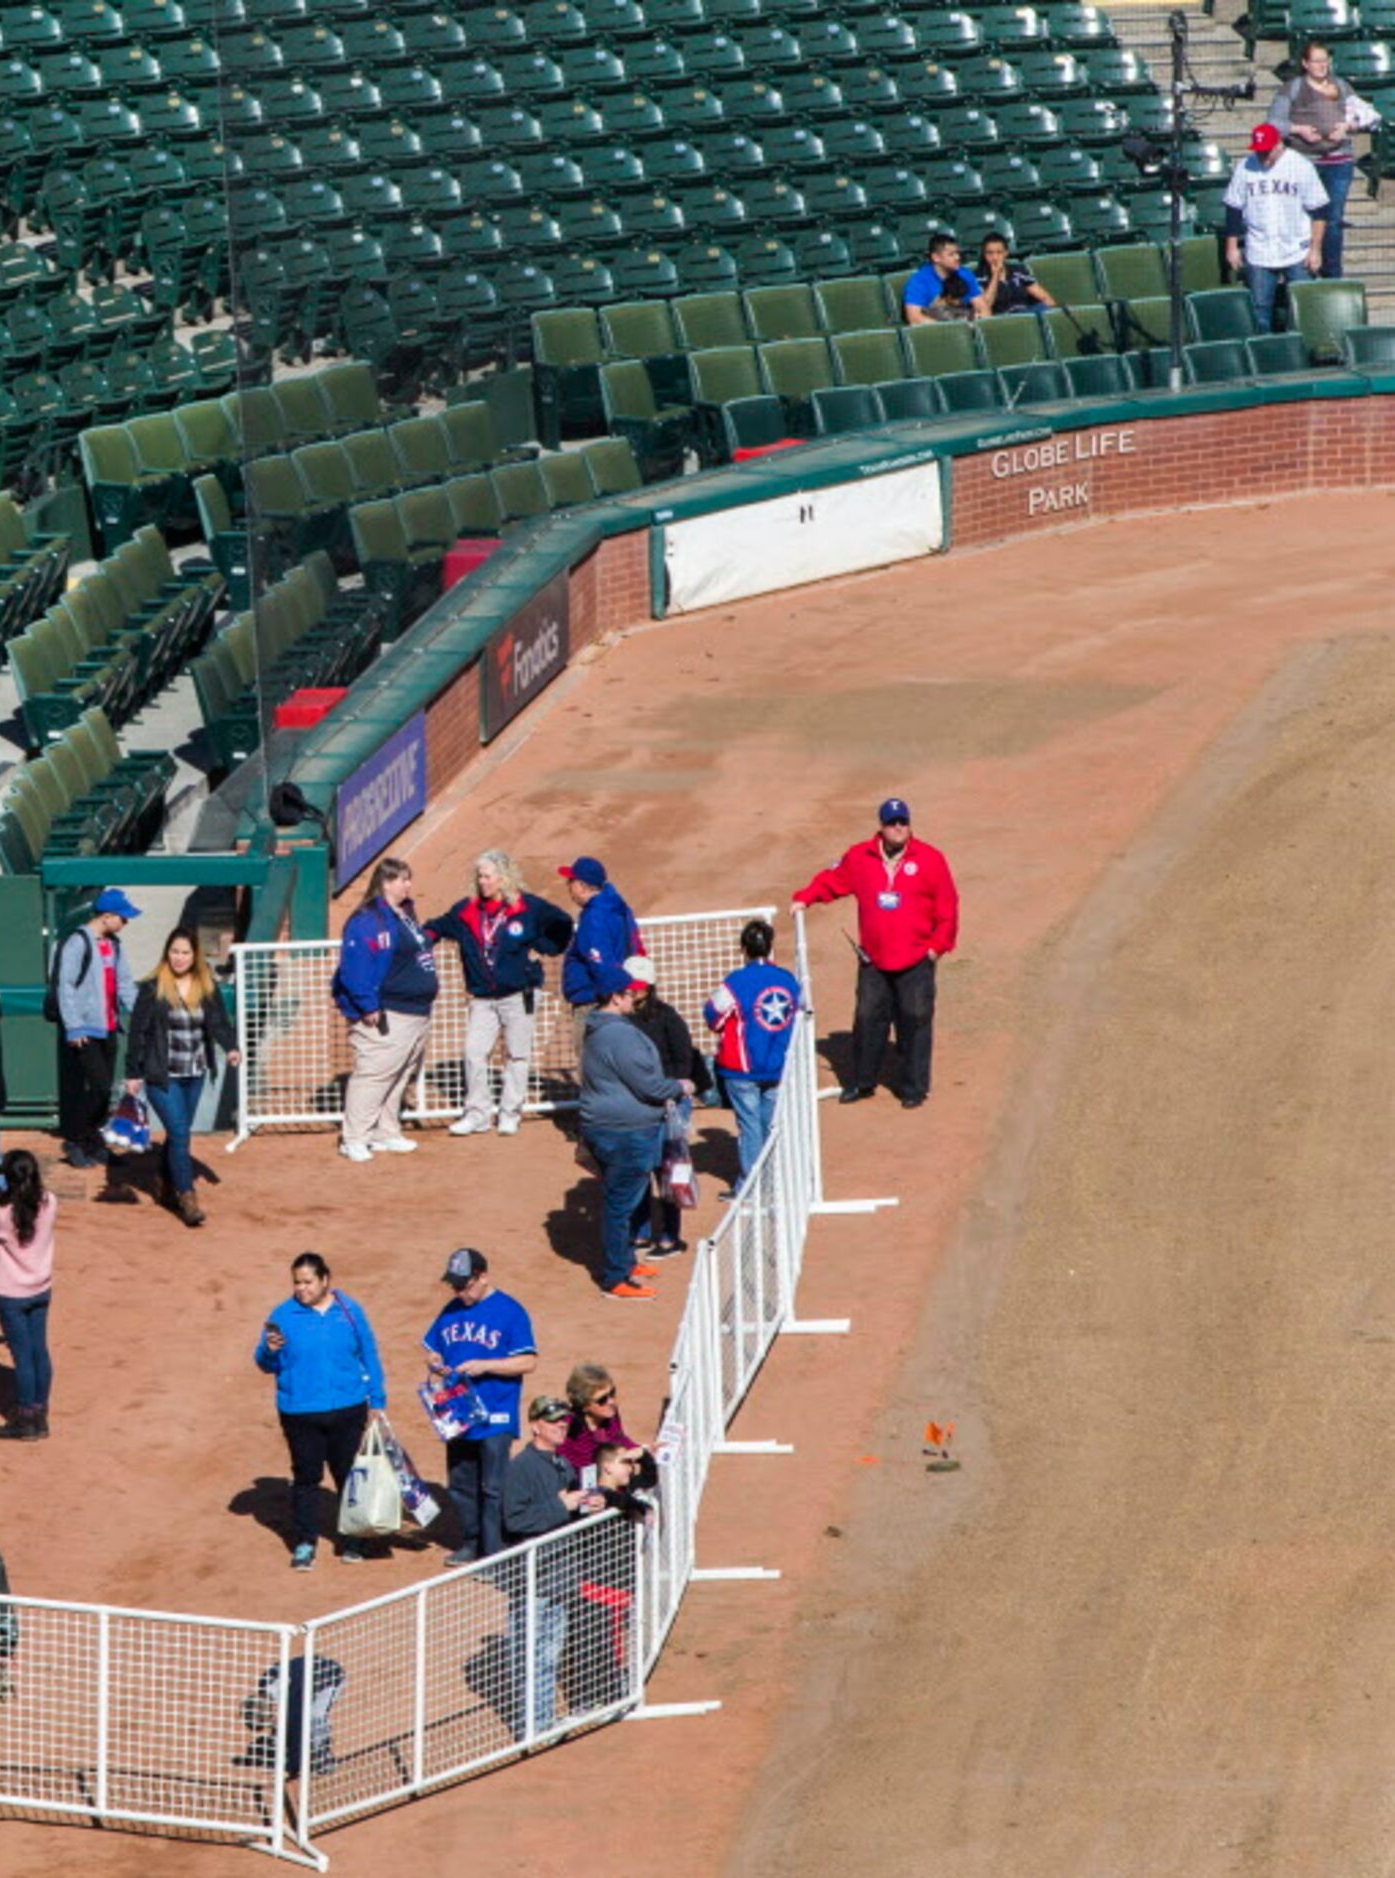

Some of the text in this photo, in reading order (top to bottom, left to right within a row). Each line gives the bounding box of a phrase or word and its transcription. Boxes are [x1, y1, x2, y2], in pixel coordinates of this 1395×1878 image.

[1246, 179, 1299, 198] TEXAS
[991, 440, 1069, 478] GLOBE
[1074, 429, 1137, 460] LIFE
[1027, 482, 1089, 515] PARK
[441, 1321, 502, 1350] TEXAS
